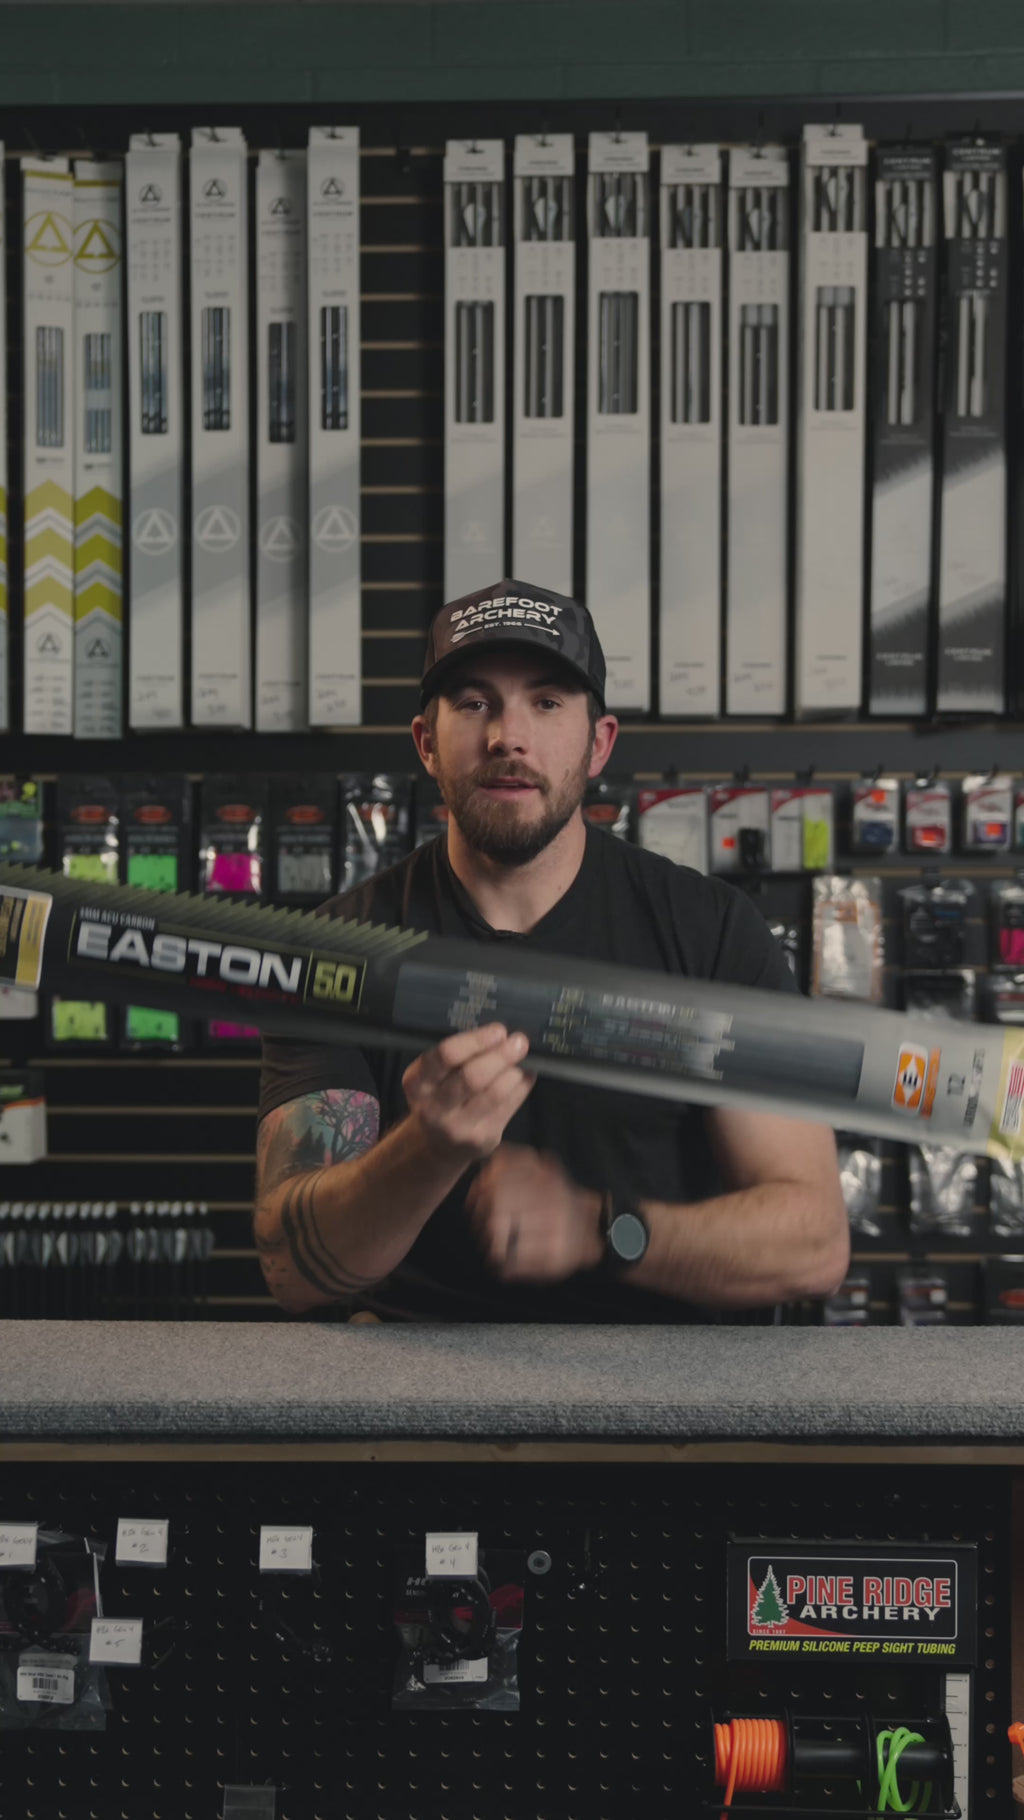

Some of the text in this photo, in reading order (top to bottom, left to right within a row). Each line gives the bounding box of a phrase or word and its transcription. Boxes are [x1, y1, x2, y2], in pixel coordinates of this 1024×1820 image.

[450, 596, 563, 622] BAREFOOT
[455, 608, 557, 632] ARCHERY
[76, 920, 303, 993] EASTON
[786, 1575, 951, 1608] PINE RIDGE
[799, 1605, 941, 1621] ARCHERY
[749, 1639, 956, 1655] PREMIUM SILICONE PEEP SIGHT TUBING
